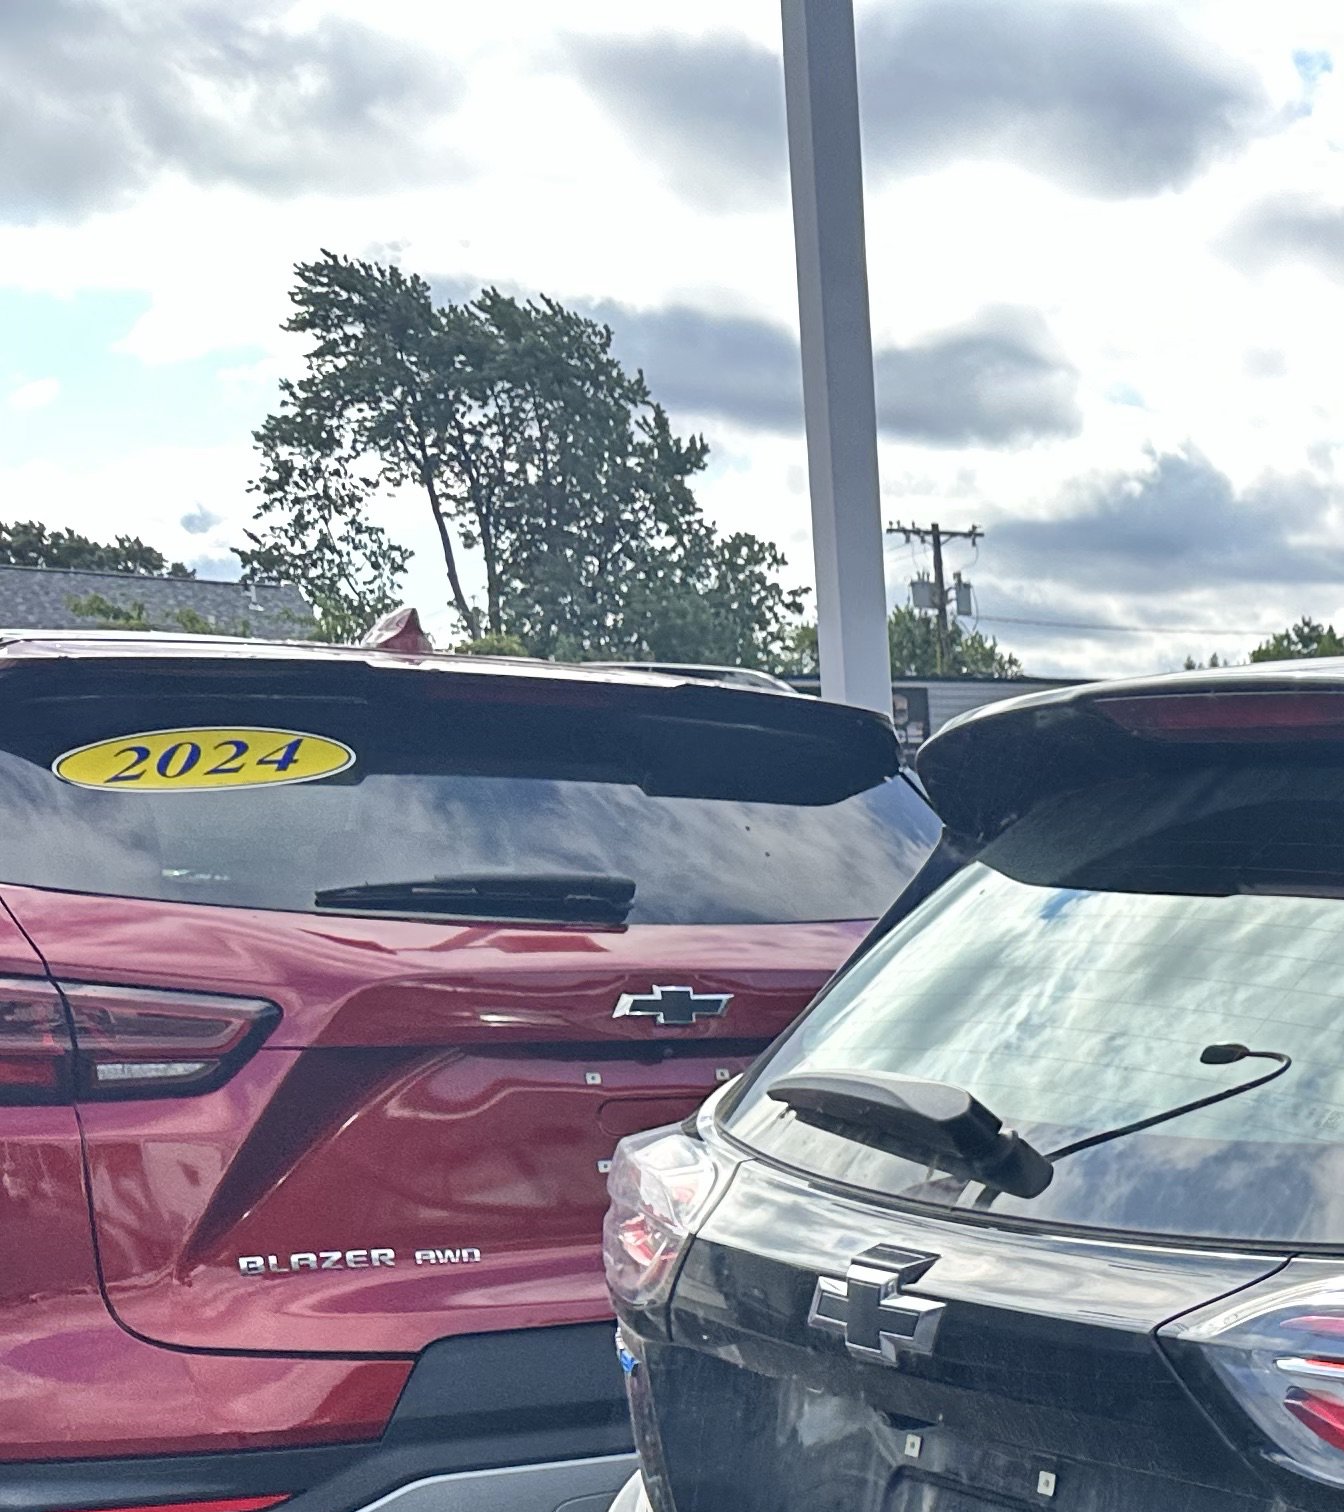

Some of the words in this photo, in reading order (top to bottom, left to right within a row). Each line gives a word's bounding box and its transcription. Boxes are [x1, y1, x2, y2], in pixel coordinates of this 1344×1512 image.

[104, 737, 305, 784] 2024
[237, 1248, 397, 1276] BLAZER
[413, 1247, 482, 1266] AWD
